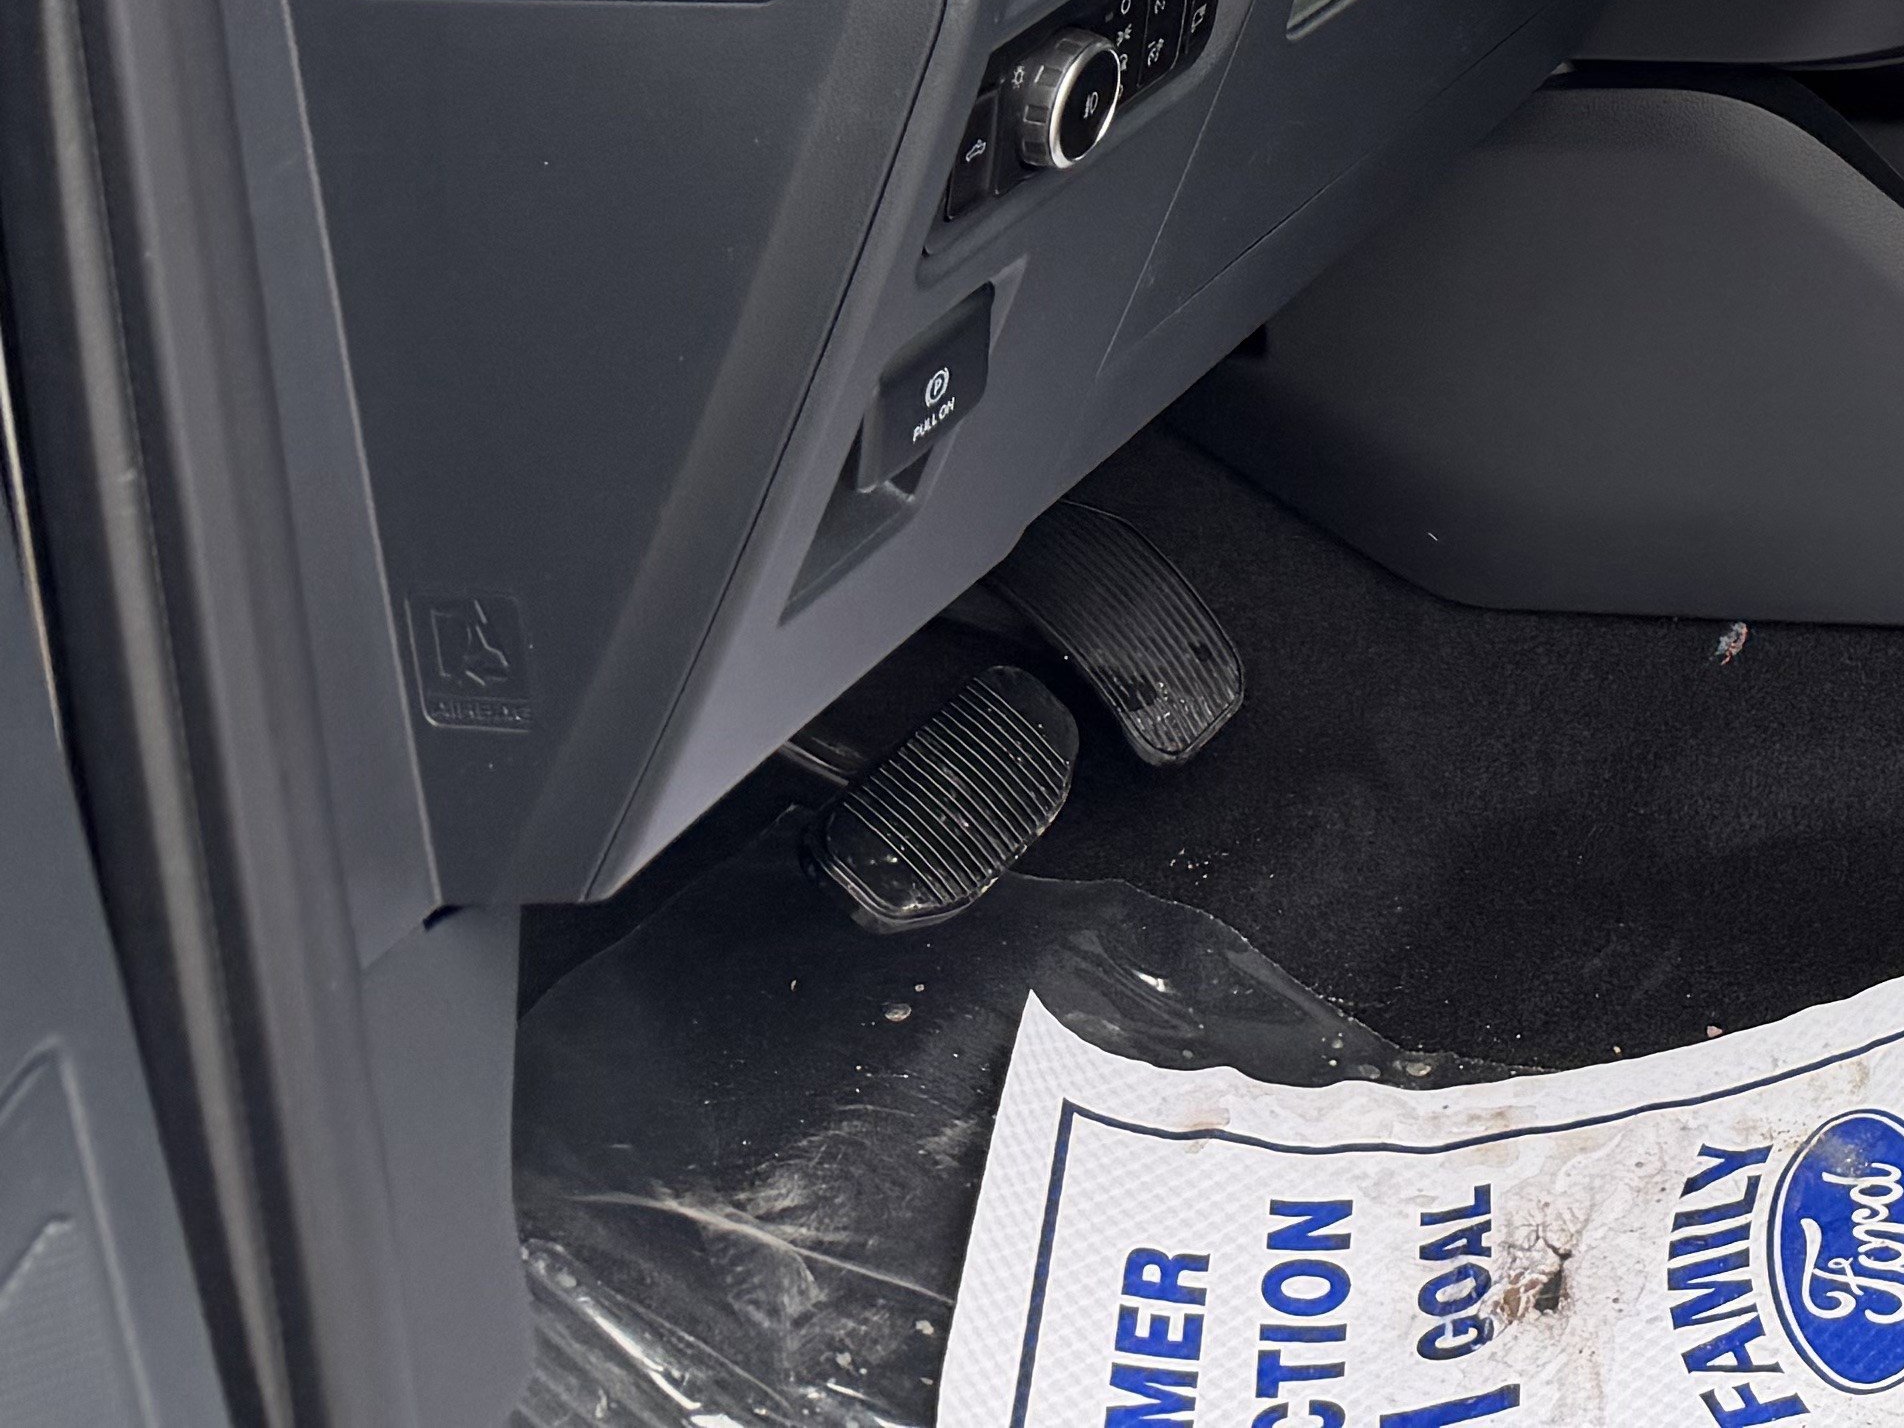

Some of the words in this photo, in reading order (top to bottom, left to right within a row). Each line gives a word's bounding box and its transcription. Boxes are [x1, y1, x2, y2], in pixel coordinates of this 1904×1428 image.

[912, 413, 938, 444] PULL
[939, 396, 955, 420] ON
[1417, 1184, 1494, 1361] GOAL
[1667, 1144, 1810, 1428] FAMILY
